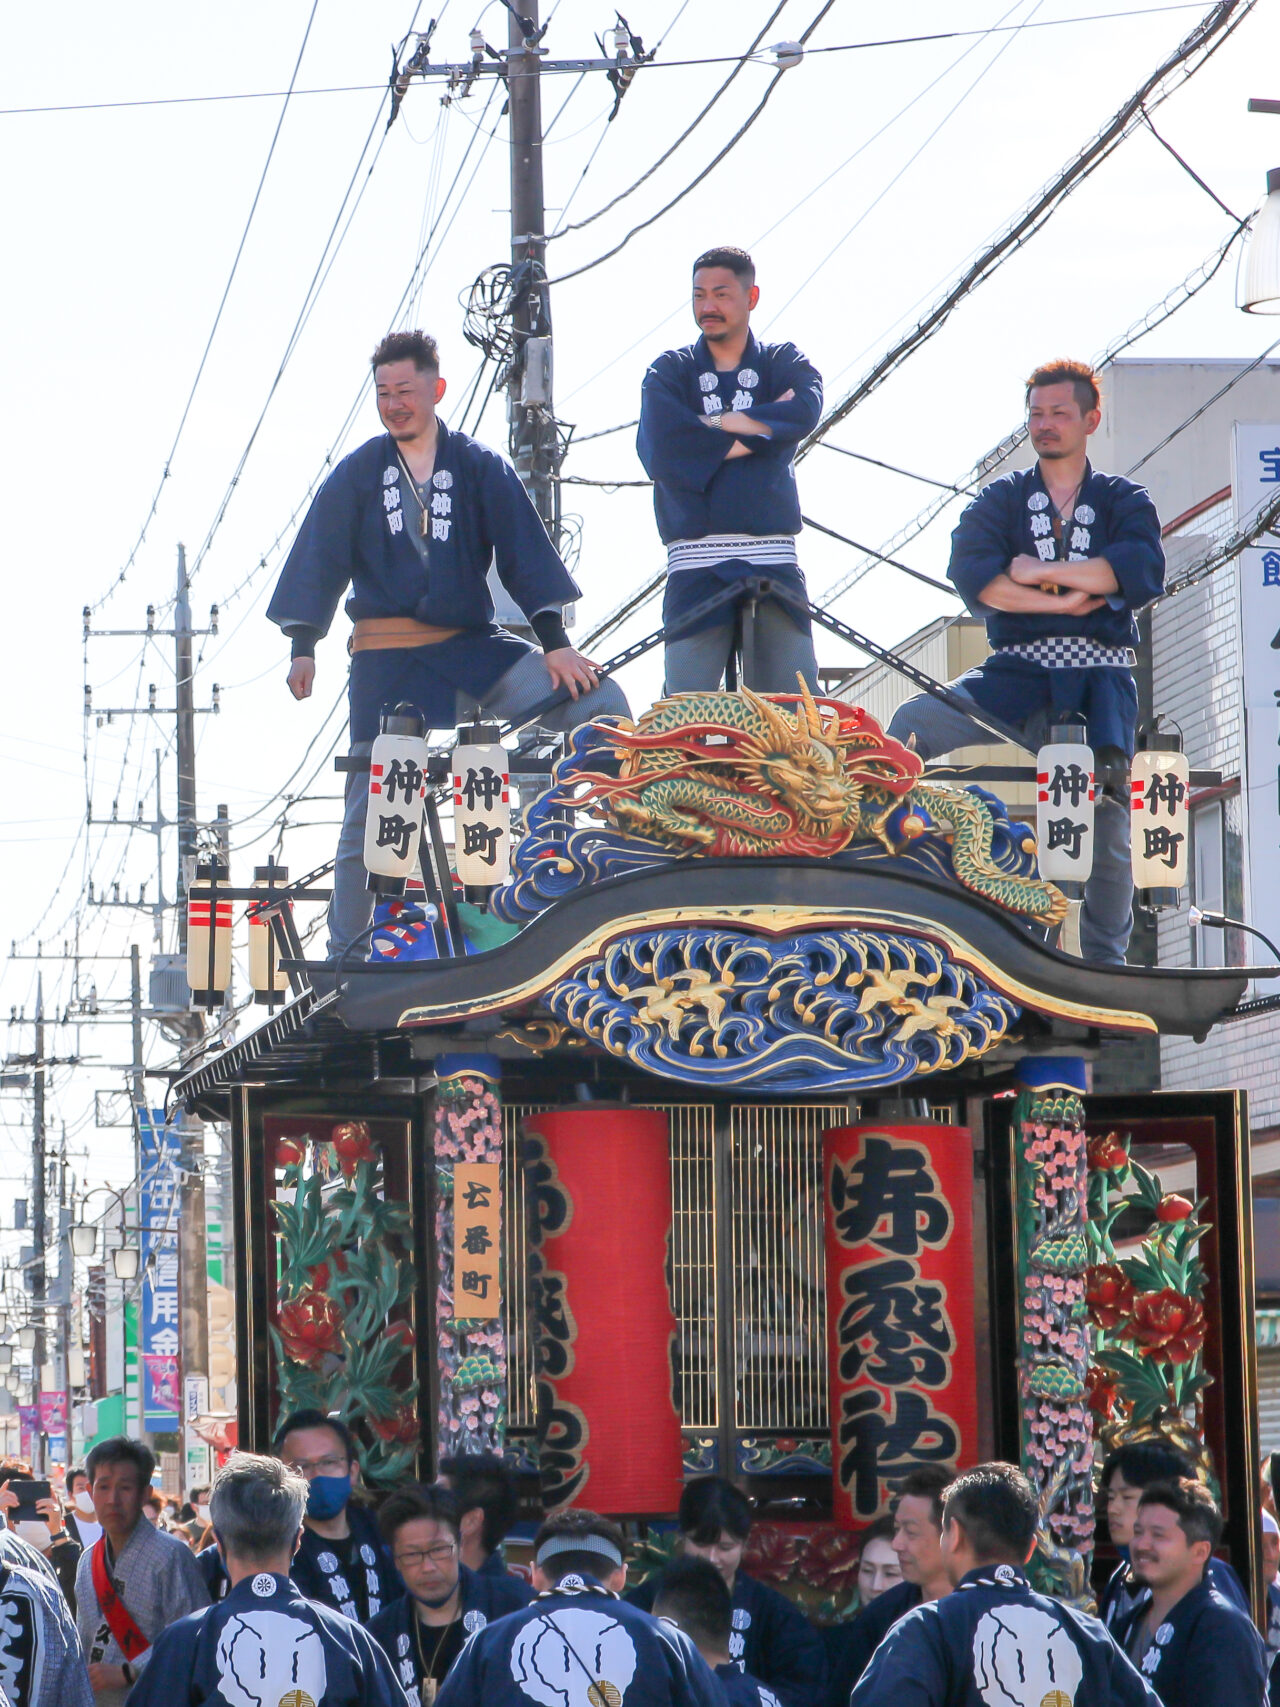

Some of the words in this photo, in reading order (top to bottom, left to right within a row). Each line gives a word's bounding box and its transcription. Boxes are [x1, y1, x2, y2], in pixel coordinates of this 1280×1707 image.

[383, 486, 403, 536] 仲町
[431, 492, 452, 542] 仲町
[1030, 512, 1055, 562] 仲町
[375, 757, 424, 861] 仲町
[462, 765, 504, 867] 仲町
[1046, 763, 1090, 861] 仲町
[1142, 772, 1186, 870] 仲町
